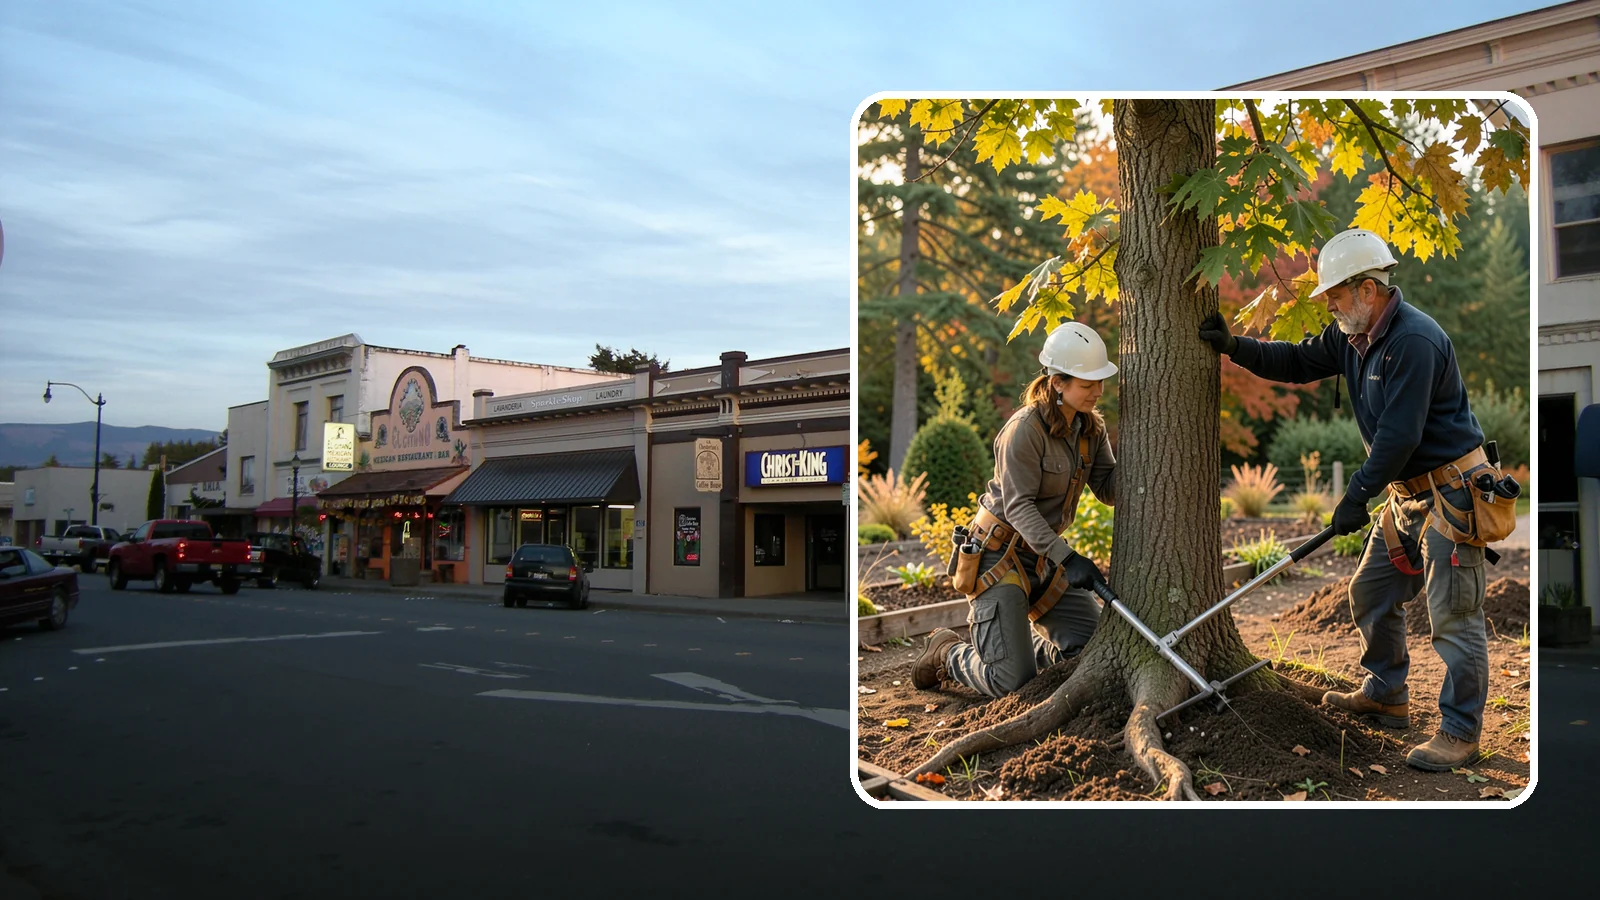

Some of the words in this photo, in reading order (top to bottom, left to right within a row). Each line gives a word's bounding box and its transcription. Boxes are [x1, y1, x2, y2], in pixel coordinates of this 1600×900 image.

[493, 402, 522, 412] LAVANDERIA
[595, 389, 624, 400] LAUNDRY
[373, 455, 396, 464] MEXICAN
[397, 451, 434, 462] RESTAURANT
[438, 450, 450, 459] BAR
